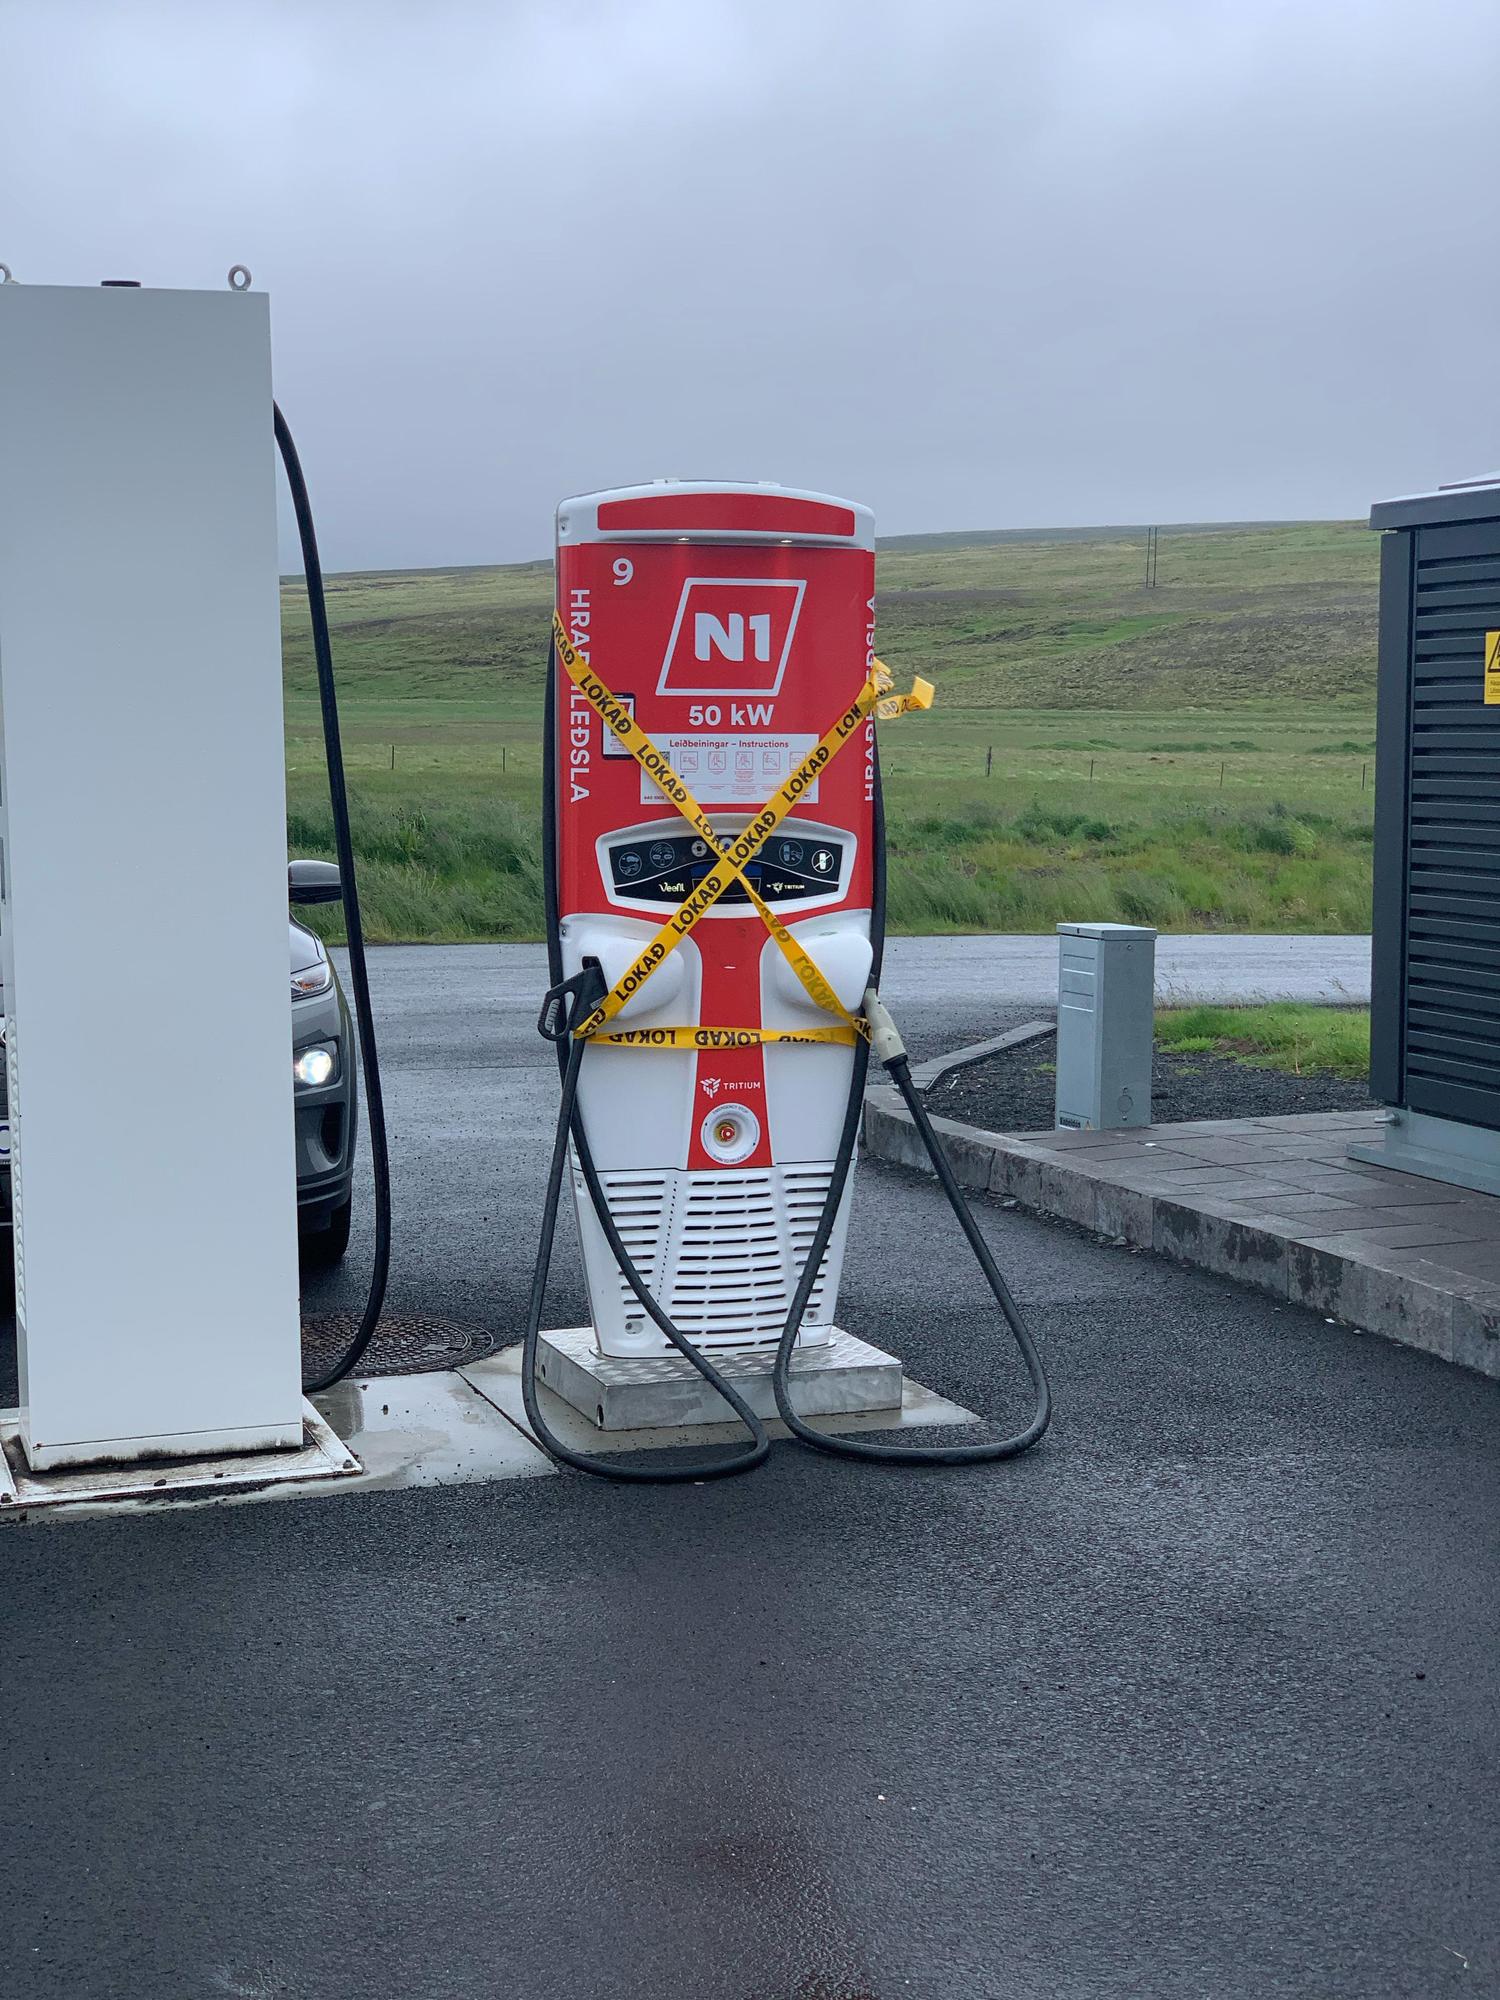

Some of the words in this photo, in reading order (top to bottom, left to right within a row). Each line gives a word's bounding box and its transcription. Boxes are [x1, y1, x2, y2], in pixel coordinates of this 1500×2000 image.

[612, 558, 634, 586] 9
[694, 612, 770, 662] N1
[579, 675, 632, 734] LOKAÐ
[688, 705, 721, 726] 50
[730, 704, 774, 726] kW
[669, 739, 729, 750] Leiðbeiningar
[739, 740, 789, 748] Instructions
[636, 744, 687, 803] LOKAÐ
[781, 746, 829, 803] LOKAÐ
[727, 810, 776, 868] LOKAÐ
[659, 882, 685, 892] Veefil
[670, 876, 721, 935] LOKAÐ
[615, 943, 665, 1002] LOKAÐ
[609, 1030, 677, 1045] LOKAÐ
[695, 1030, 761, 1046] LOKAÐ
[723, 1082, 760, 1090] TRITIUM
